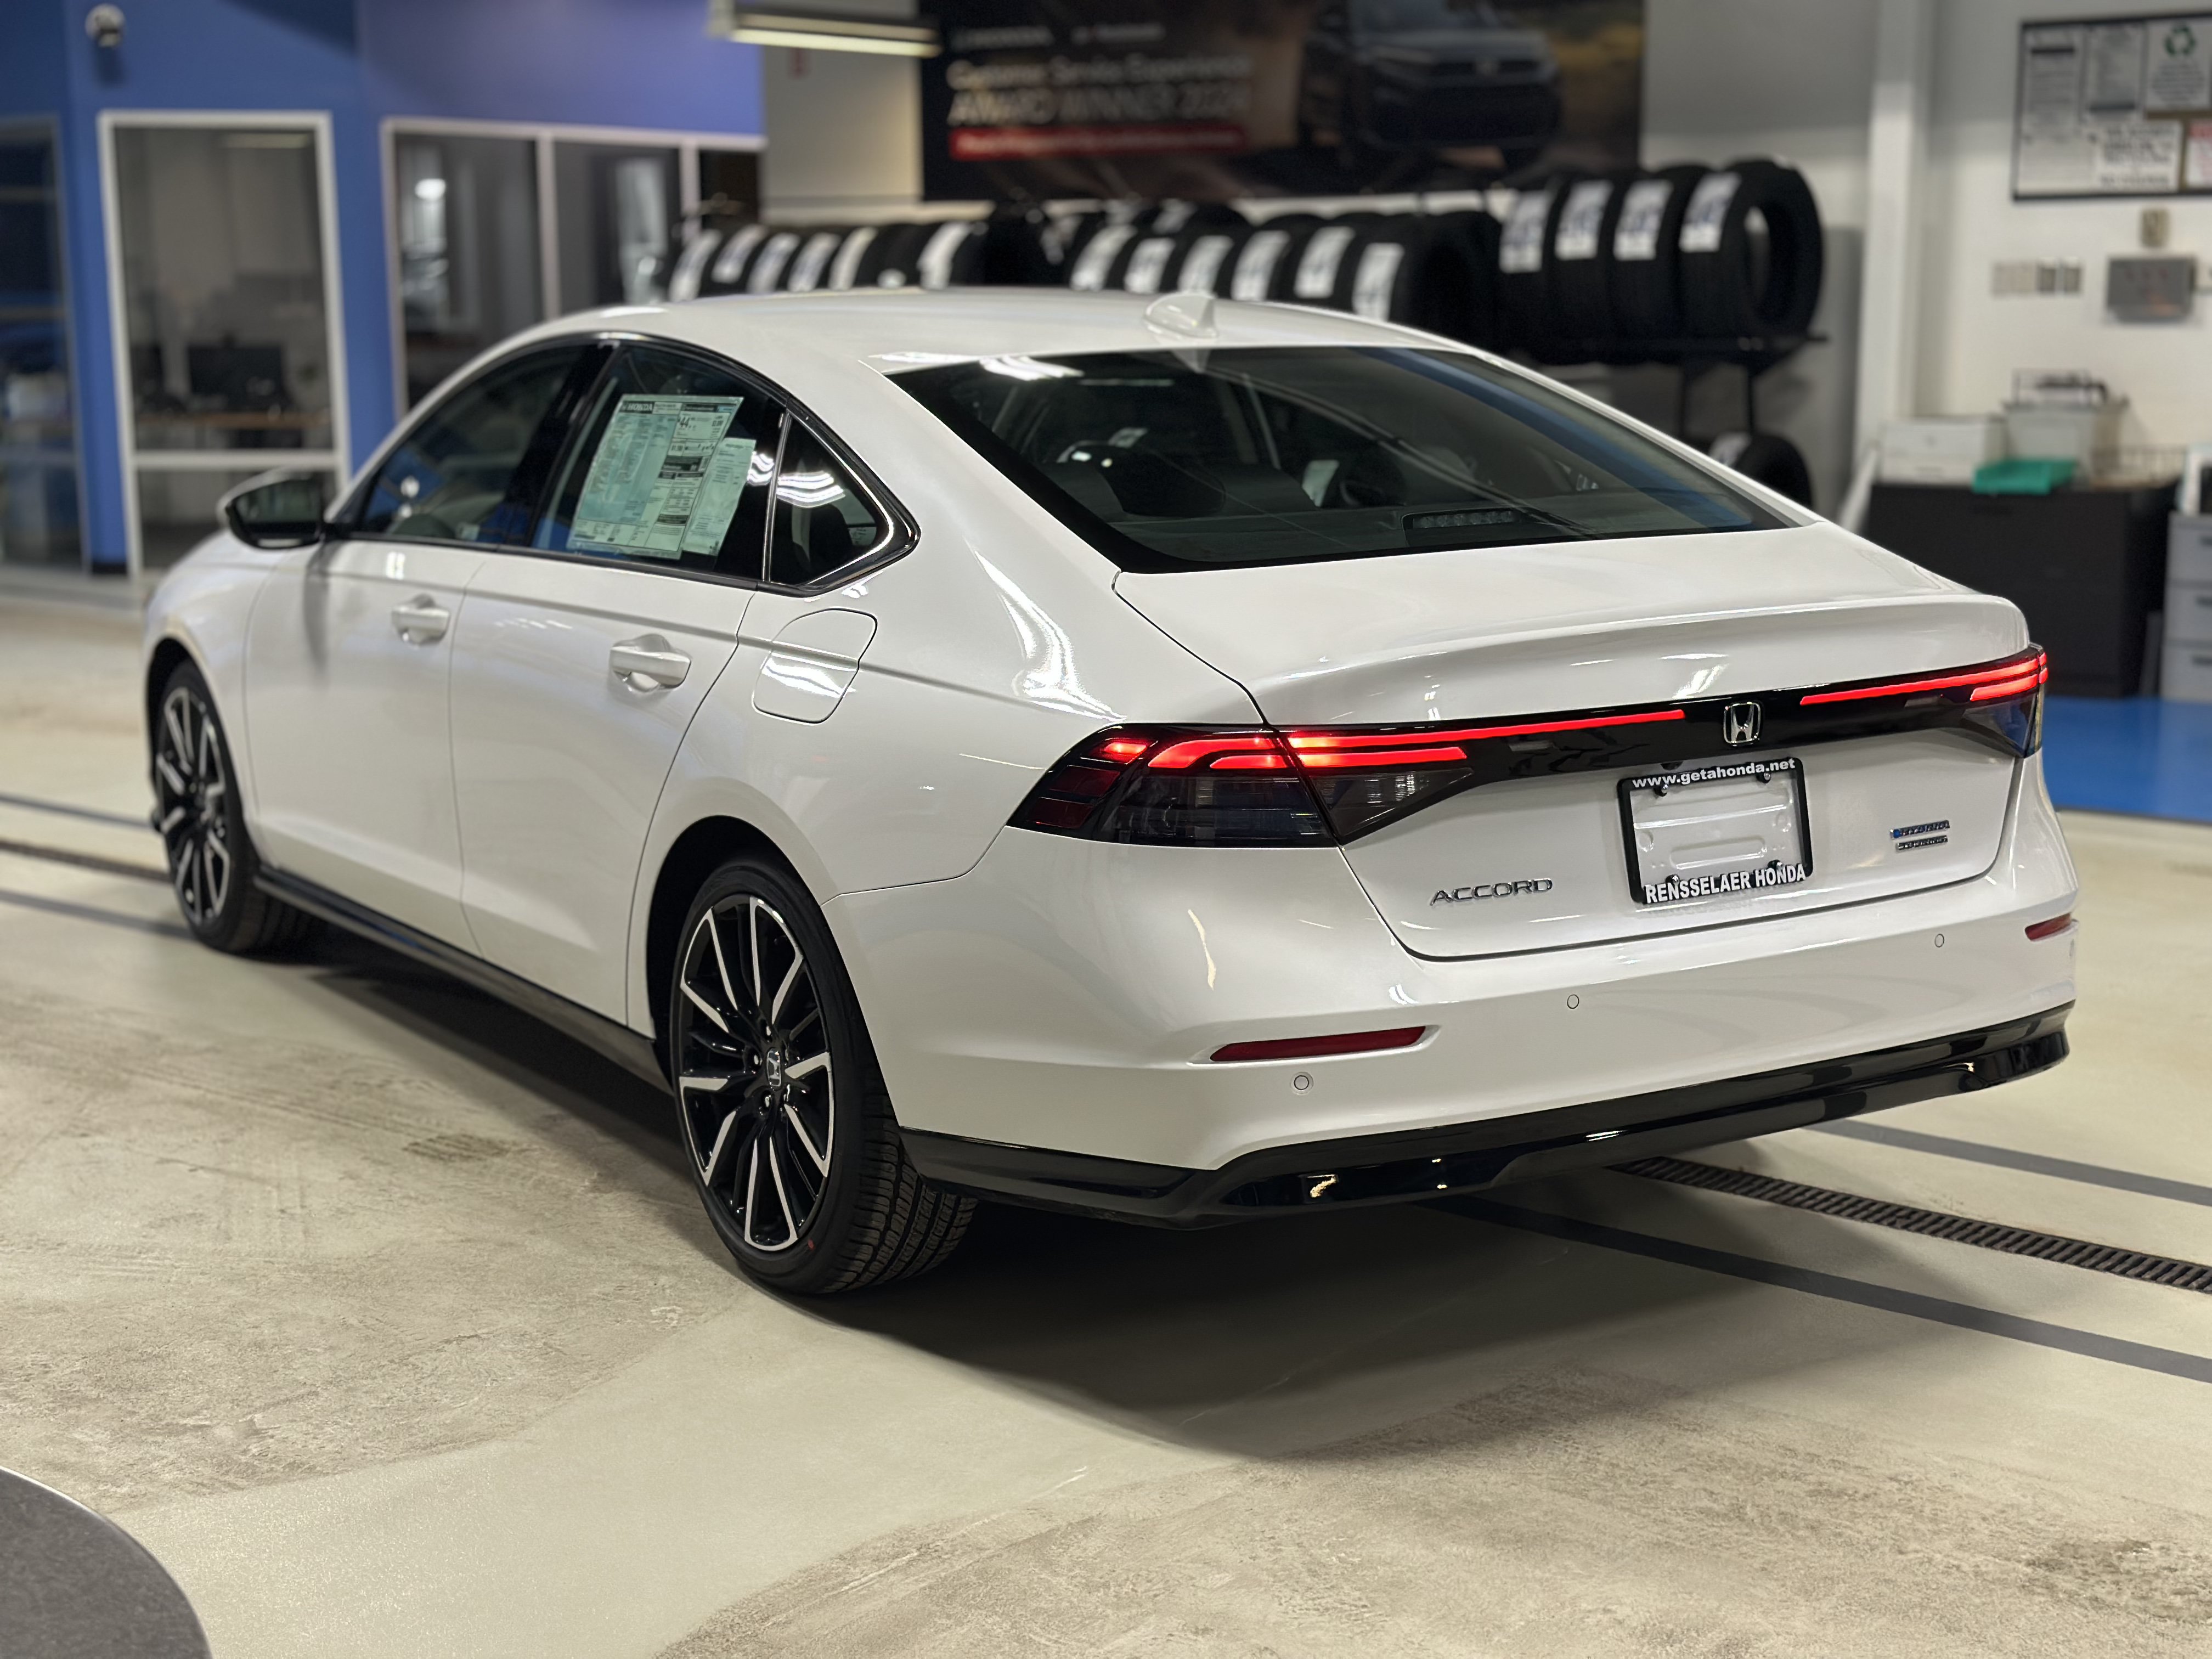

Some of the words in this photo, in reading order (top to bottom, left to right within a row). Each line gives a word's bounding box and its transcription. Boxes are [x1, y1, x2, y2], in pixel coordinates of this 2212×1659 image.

[1632, 758, 1796, 788] www.getahonda.net
[1429, 878, 1553, 906] ACCORD
[1646, 871, 1751, 904] RENSSELAER
[1755, 863, 1806, 887] HONDA
